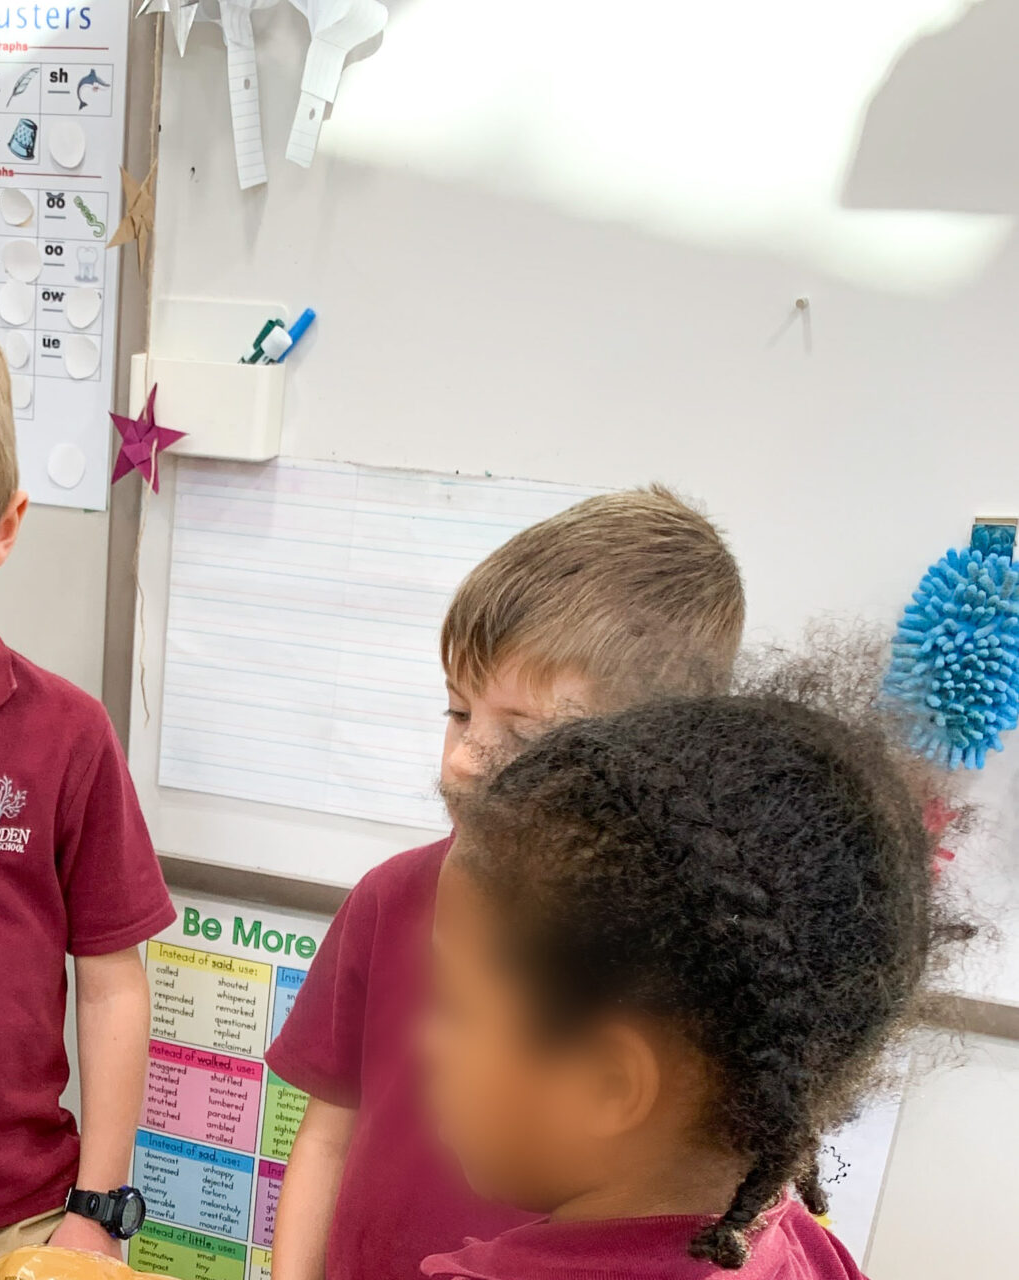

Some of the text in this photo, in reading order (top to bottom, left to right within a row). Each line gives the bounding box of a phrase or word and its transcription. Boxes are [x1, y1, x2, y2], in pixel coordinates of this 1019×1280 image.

[50, 69, 68, 83] sh
[183, 907, 317, 959] Be More
[159, 945, 258, 977] Instead of said, use:
[156, 966, 179, 977] called
[155, 978, 175, 989] cried
[218, 979, 249, 992] shouted
[154, 991, 194, 1006] responded
[217, 992, 256, 1006] whispered
[153, 1002, 194, 1017] demanded
[216, 1004, 255, 1018] remarked
[153, 1014, 175, 1026] asked
[214, 1017, 256, 1031] questioned
[152, 1027, 177, 1038] stated
[214, 1029, 240, 1040] replied
[213, 1040, 252, 1055] exclaimed
[150, 1061, 187, 1075] staggered
[185, 1051, 256, 1075] of walked, use:
[149, 1073, 180, 1085] traveled
[211, 1074, 243, 1087] shuffled
[149, 1084, 178, 1097] trudged
[210, 1086, 247, 1100] sauntered
[148, 1096, 177, 1108] strutted
[209, 1096, 245, 1111] lumbered
[147, 1108, 181, 1121] marched
[207, 1110, 241, 1123] paraded
[147, 1118, 166, 1129] hiked
[206, 1122, 235, 1133] ambled
[206, 1133, 234, 1145] strolled
[148, 1134, 240, 1168] Instead of sad, use:
[145, 1151, 179, 1165] downcast
[144, 1162, 179, 1176] depressed
[203, 1166, 235, 1181] unhappy
[143, 1173, 166, 1185] woeful
[202, 1177, 234, 1190] dejected
[142, 1184, 167, 1198] gloomy
[202, 1187, 227, 1200] forlorn
[201, 1199, 241, 1216] melancholy
[200, 1211, 239, 1226] crestfallen
[199, 1221, 232, 1234] mournful
[140, 1237, 158, 1249] teeny
[176, 1232, 188, 1243] of
[189, 1234, 215, 1251] little,
[139, 1248, 174, 1262] diminutive
[197, 1252, 216, 1262] small
[138, 1259, 169, 1272] compact
[196, 1263, 210, 1273] tiny
